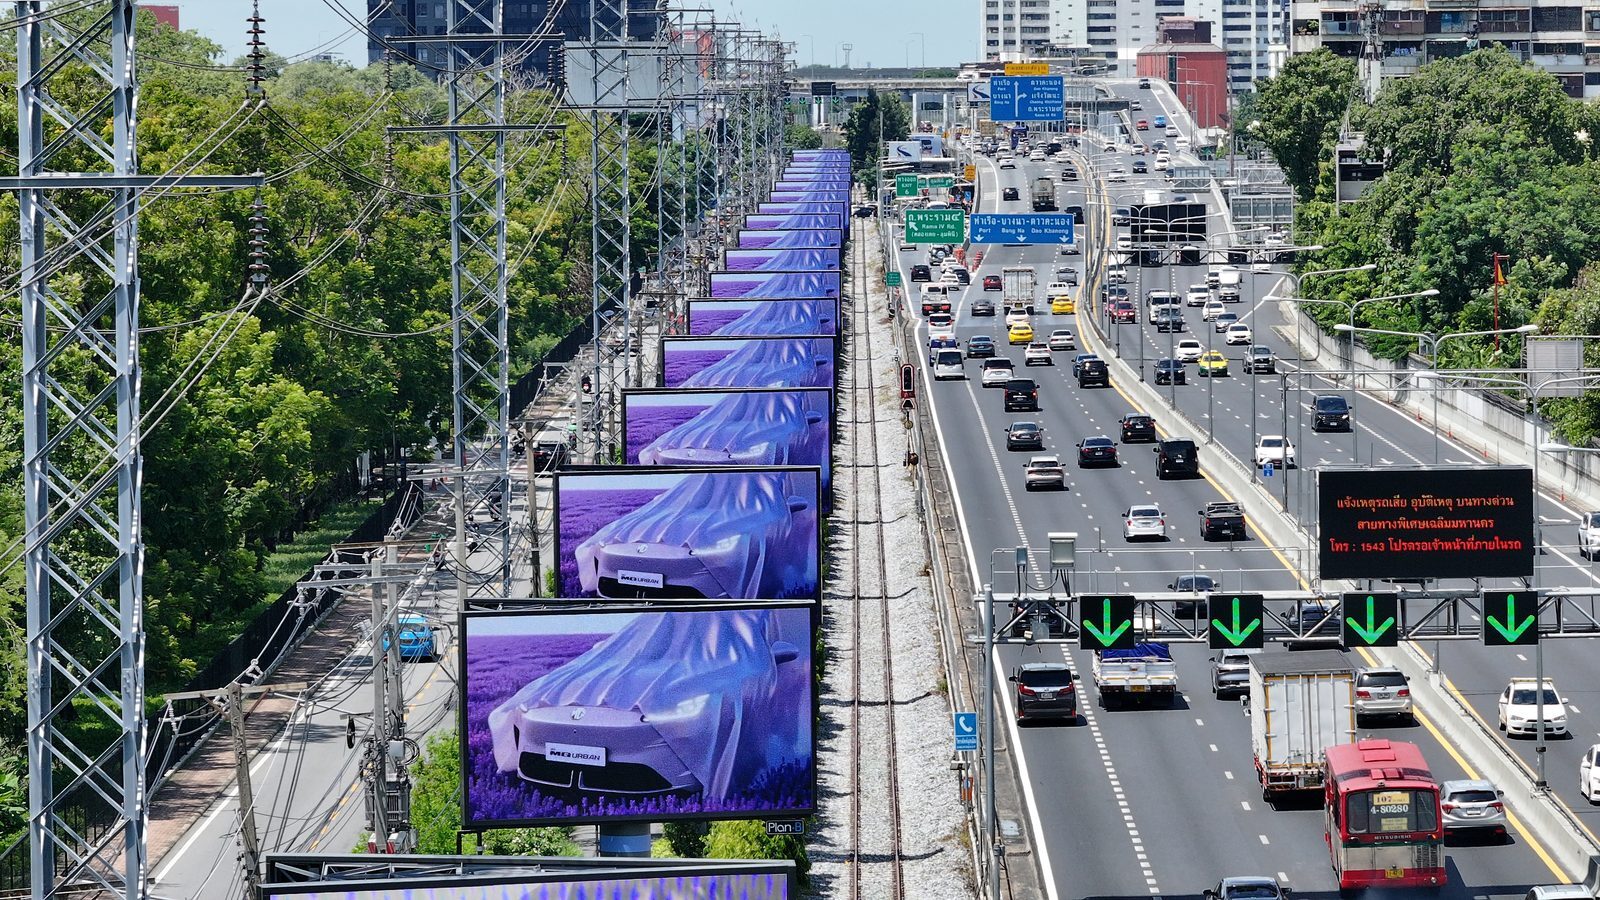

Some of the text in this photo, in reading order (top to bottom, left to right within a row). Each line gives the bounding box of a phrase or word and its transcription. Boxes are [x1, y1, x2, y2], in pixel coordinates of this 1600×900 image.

[1337, 494, 1514, 512] แจ้งเหตุรถเสีย อุบัติเหตุ บนทางด่วน
[1358, 516, 1494, 529] สายทางพิเศษเฉลิมมหานคร
[1330, 538, 1349, 552] โทร
[1361, 542, 1385, 552] 1543
[572, 752, 600, 760] URBAN
[1370, 804, 1408, 814] 4-80280
[768, 822, 792, 832] Plan
